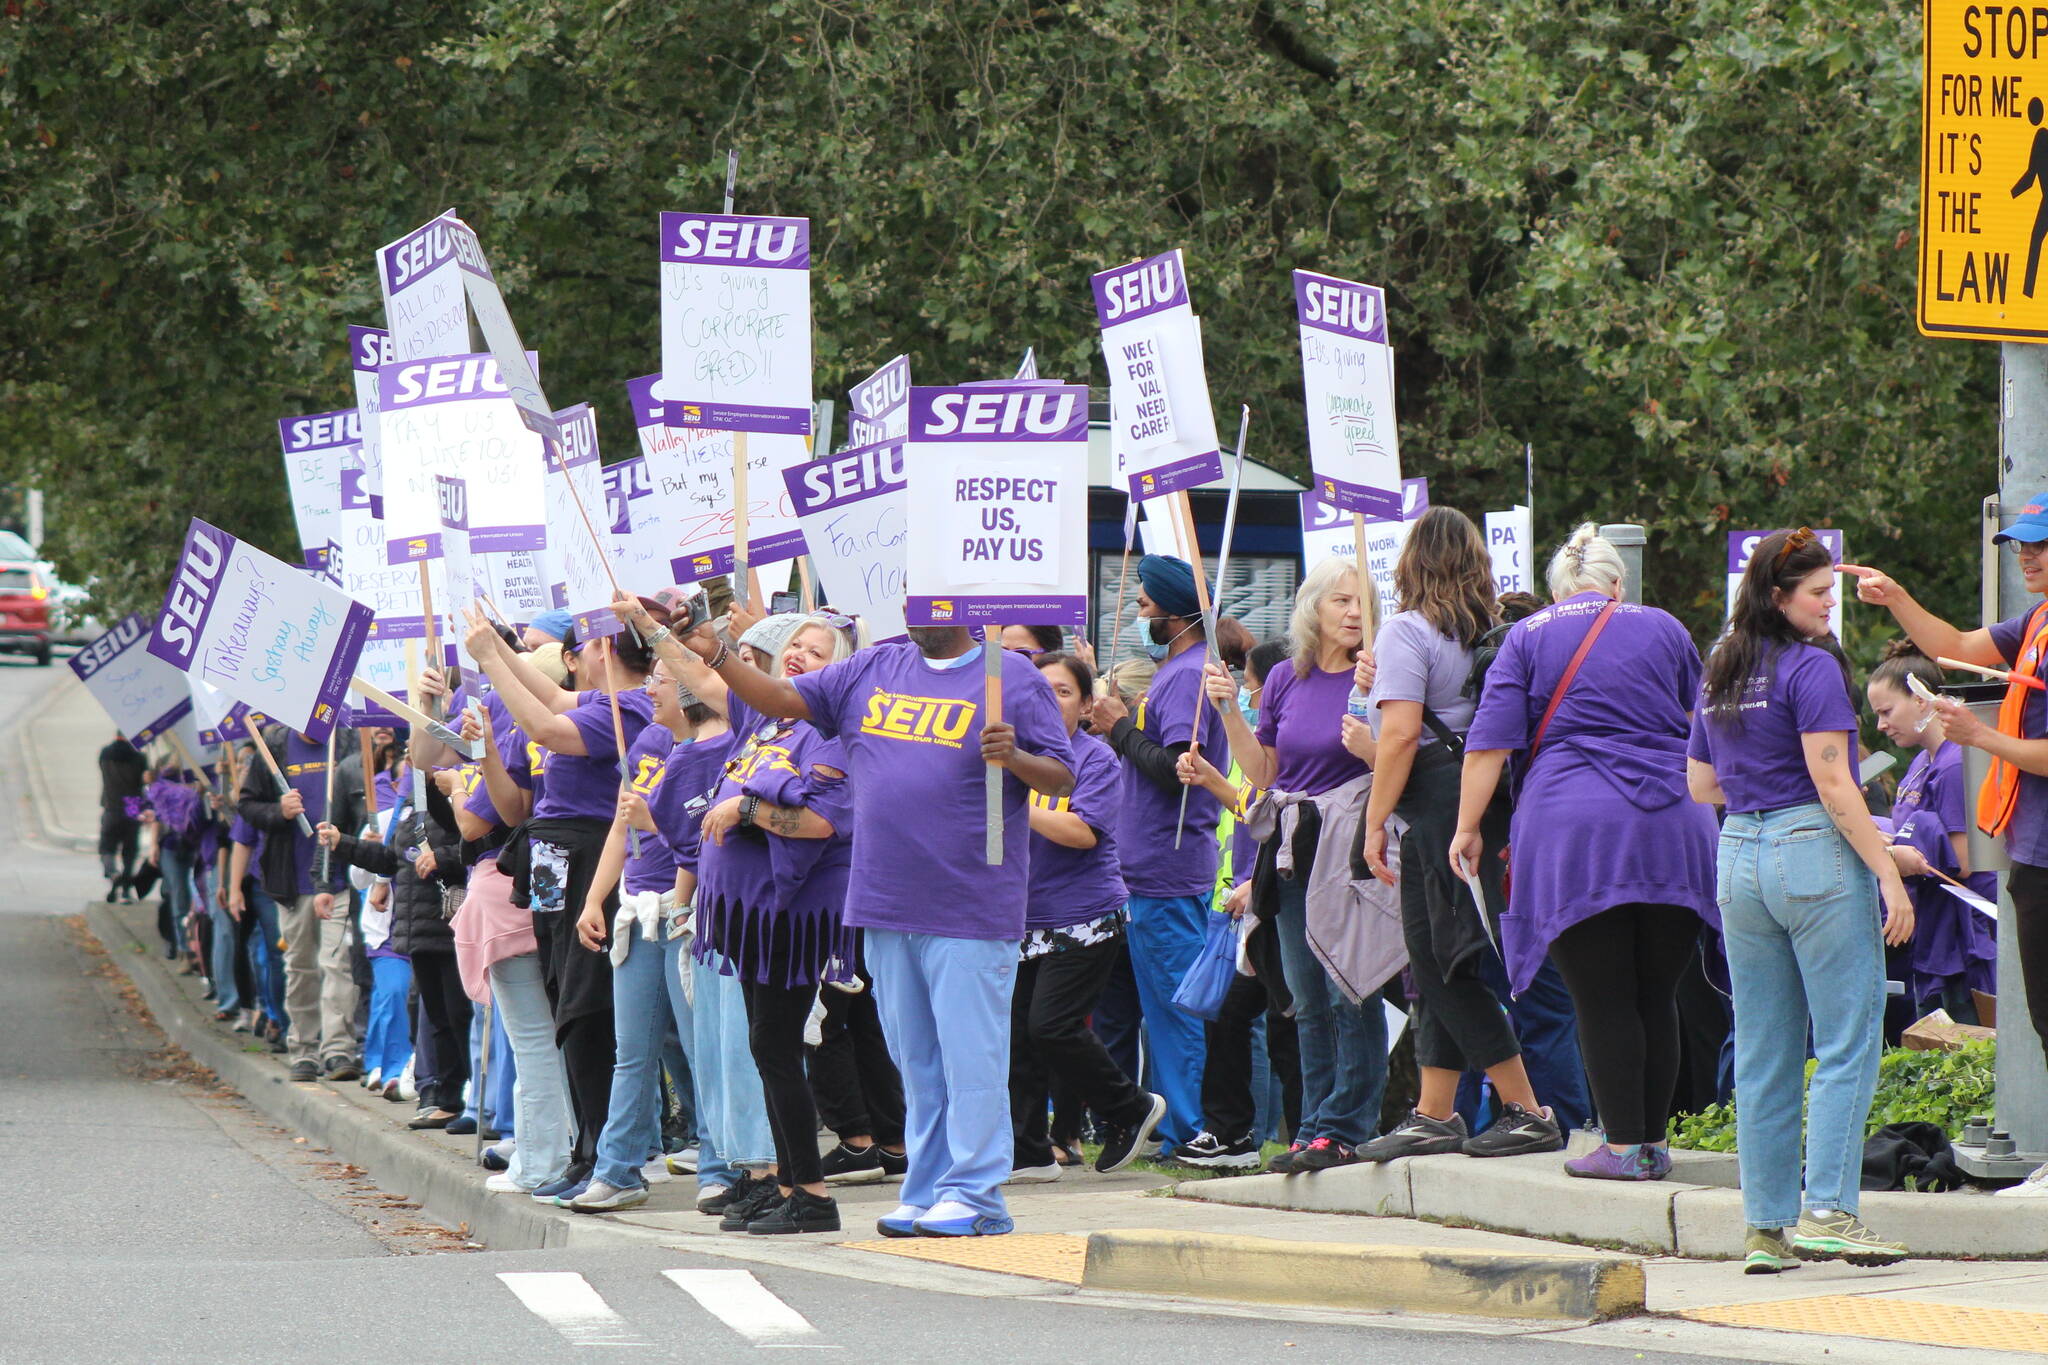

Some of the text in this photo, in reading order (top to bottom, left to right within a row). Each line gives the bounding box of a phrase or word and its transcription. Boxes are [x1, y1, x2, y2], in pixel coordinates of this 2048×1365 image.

[1963, 5, 2048, 59] STOP
[1941, 74, 2022, 118] FOR ME
[1939, 132, 1982, 175] IT'S
[1938, 191, 1982, 234] THE
[395, 224, 451, 286] SEIU
[450, 227, 487, 273] SEIU
[674, 219, 798, 262] SEIU
[718, 271, 768, 311] giving
[1104, 260, 1175, 320] SEIU
[1936, 249, 2010, 304] LAW
[1305, 281, 1375, 333] SEIU
[361, 333, 393, 367] SE
[1122, 341, 1147, 361] WE
[1334, 346, 1366, 385] giving
[1128, 361, 1155, 380] FOR
[861, 363, 905, 418] SEIU
[1136, 398, 1166, 419] NEED
[925, 393, 1075, 435] SEIU
[1130, 422, 1163, 440] CARE
[699, 470, 718, 488] my
[803, 447, 907, 507] SEIU
[956, 477, 1057, 503] RESPECT
[439, 483, 463, 521] EIU
[981, 507, 1020, 534] US,
[356, 525, 386, 547] OU
[963, 538, 1043, 561] PAY US
[1331, 544, 1357, 556] SAM
[1491, 527, 1517, 545] PA
[328, 546, 343, 580] SE
[348, 569, 417, 593] DESERV
[694, 564, 713, 573] SEIU
[161, 529, 223, 657] SEIU
[505, 577, 522, 588] BUT
[292, 597, 336, 663] Away
[931, 610, 952, 618] SEIU
[79, 617, 140, 675] SEIU
[862, 693, 976, 740] SEIU
[933, 737, 962, 749] UNION
